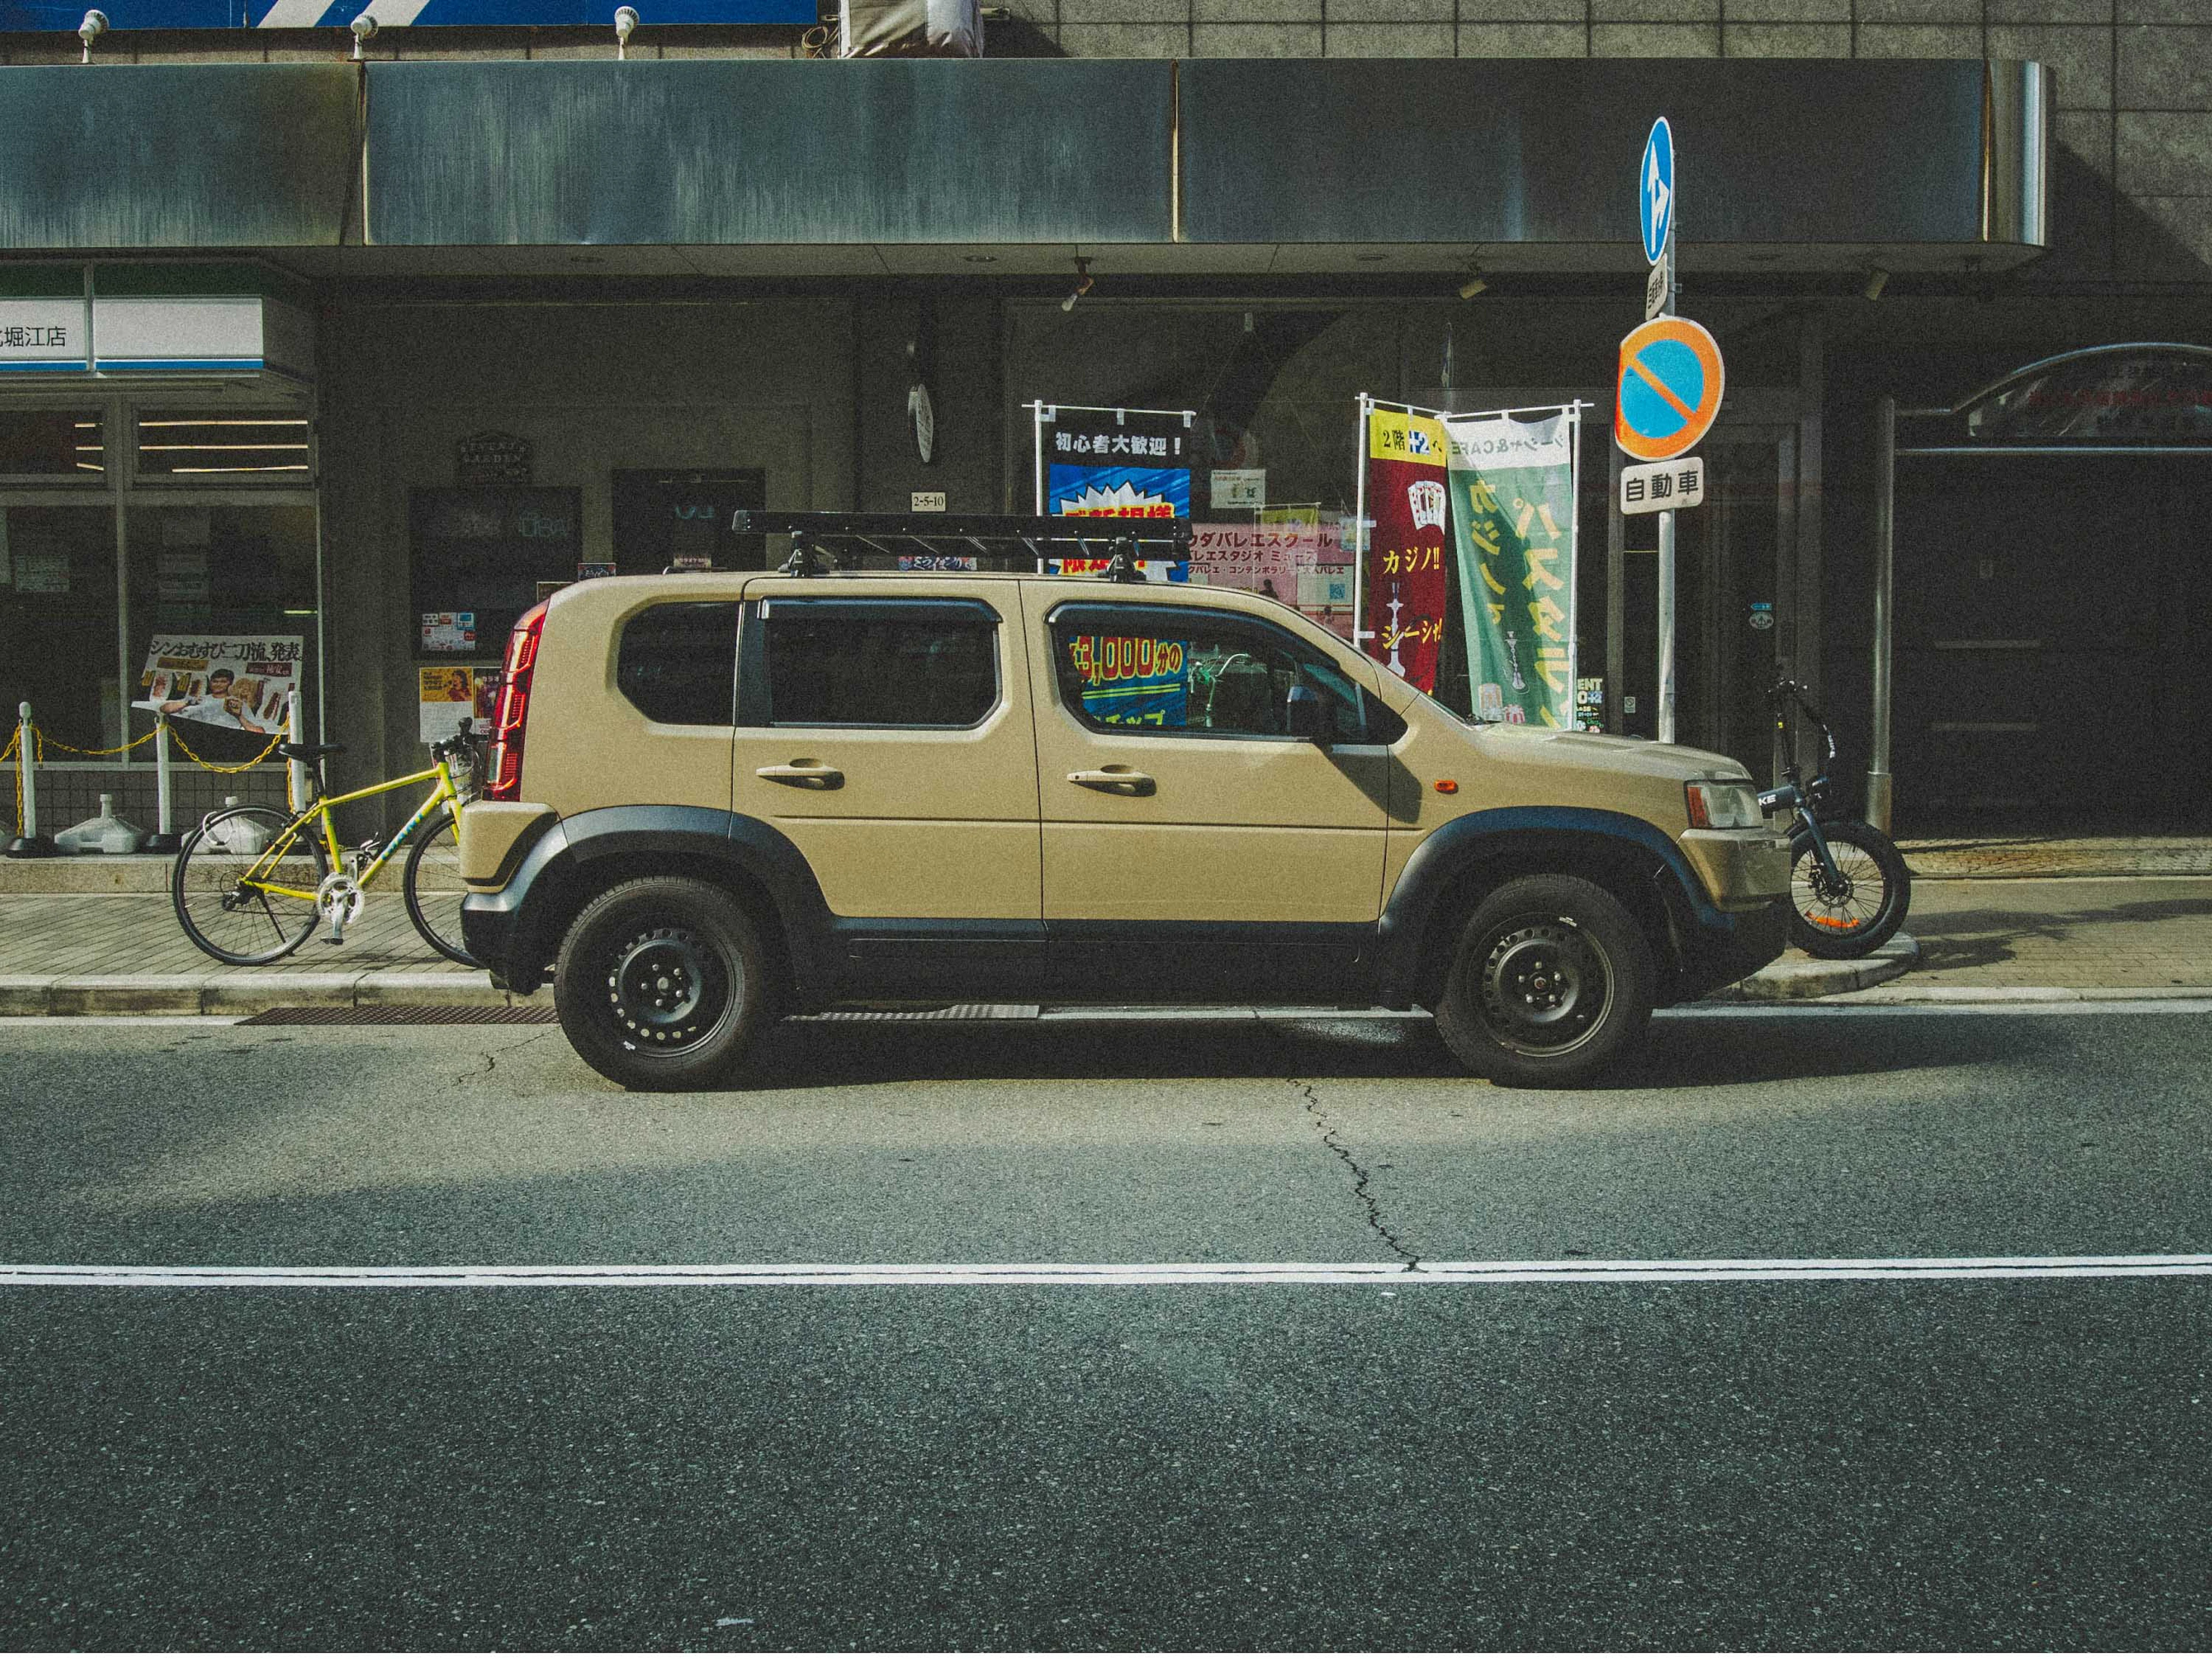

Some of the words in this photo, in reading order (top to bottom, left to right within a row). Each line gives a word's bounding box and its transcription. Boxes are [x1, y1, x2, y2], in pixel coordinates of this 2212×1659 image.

[1055, 431, 1181, 456] 初心者大歓迎！
[1626, 470, 1699, 502] 自動車
[914, 496, 944, 506] 2-5-10
[1190, 550, 1264, 562] レエスタジオ
